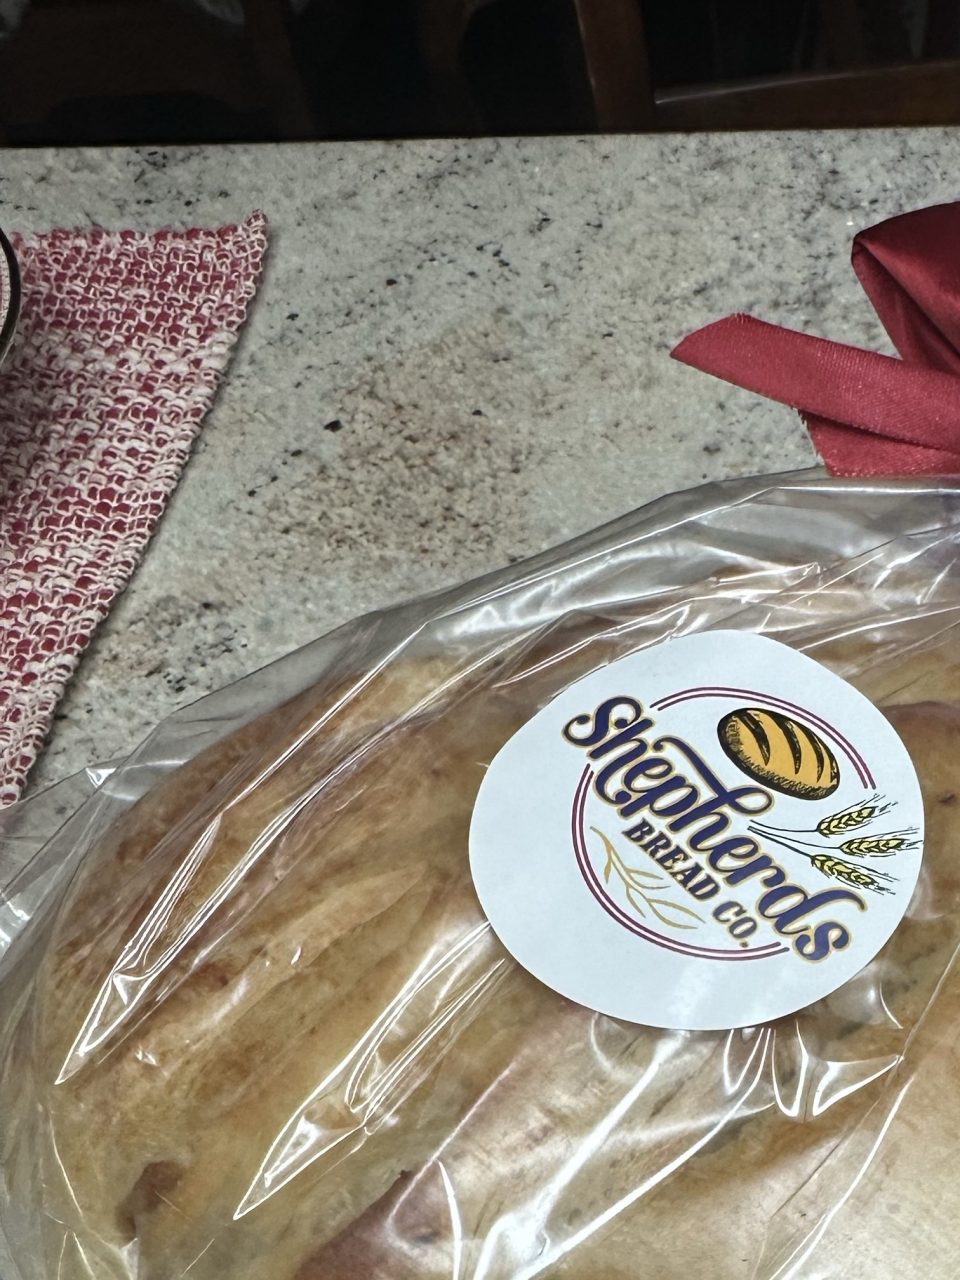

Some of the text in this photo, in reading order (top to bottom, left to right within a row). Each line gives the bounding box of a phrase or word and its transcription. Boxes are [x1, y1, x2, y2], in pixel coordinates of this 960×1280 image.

[563, 697, 866, 961] Shepherds
[623, 818, 760, 947] BREAD CO.
